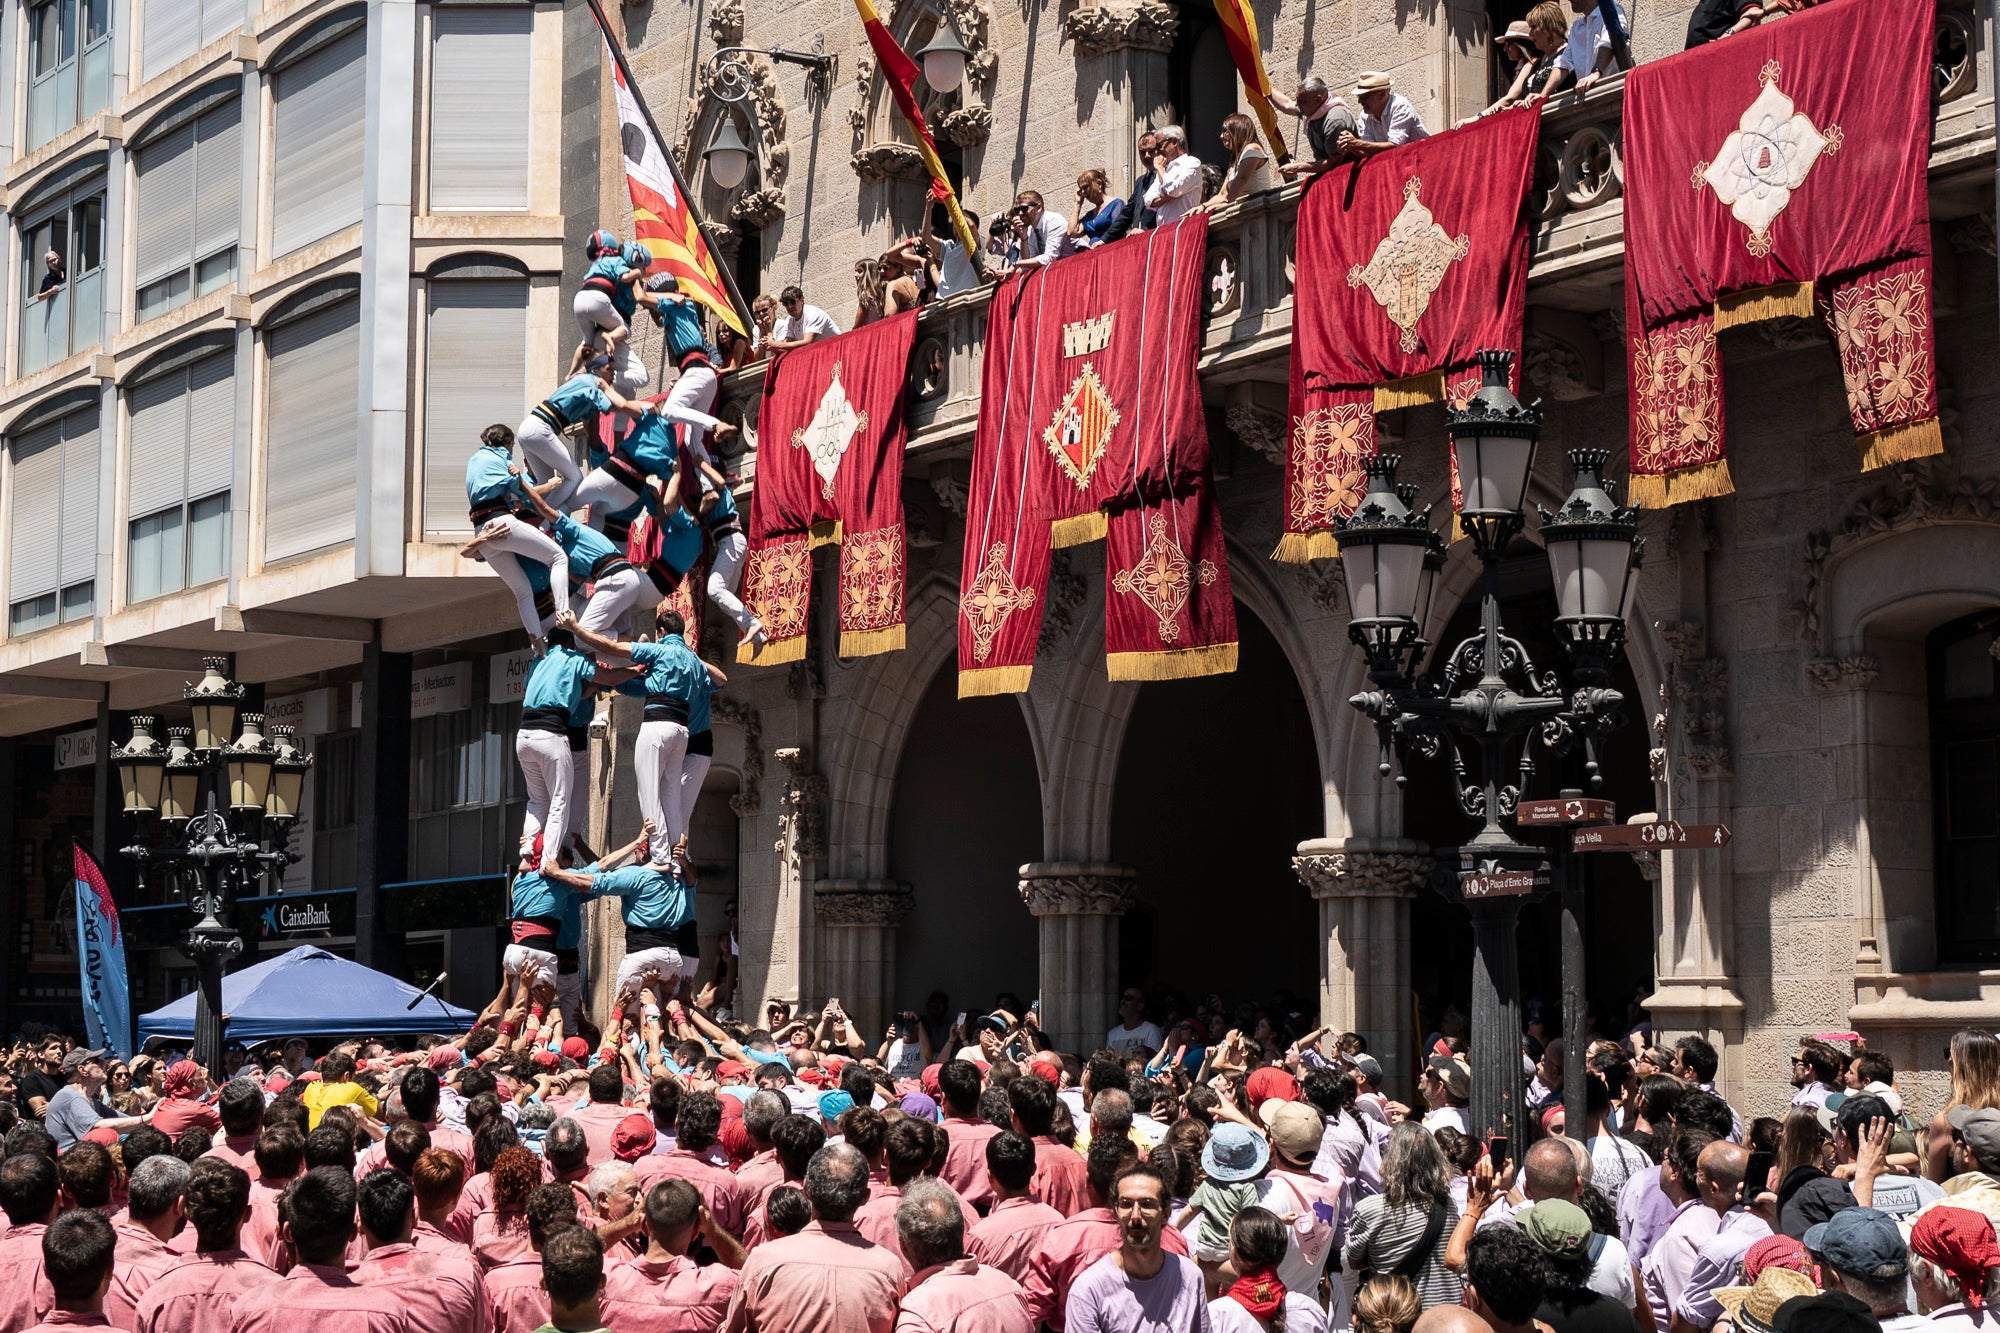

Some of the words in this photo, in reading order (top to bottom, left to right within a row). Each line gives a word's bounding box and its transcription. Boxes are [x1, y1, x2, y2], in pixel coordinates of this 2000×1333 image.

[424, 674, 456, 690] Mediadors
[264, 698, 304, 719] Advocats
[1574, 835, 1585, 846] aça
[1586, 833, 1602, 843] Vella
[1489, 879, 1504, 891] Plaça
[1504, 877, 1522, 888] d'Enric
[1522, 876, 1551, 886] Granados
[280, 902, 331, 927] CaixaBank
[1872, 1192, 1915, 1206] DENALI
